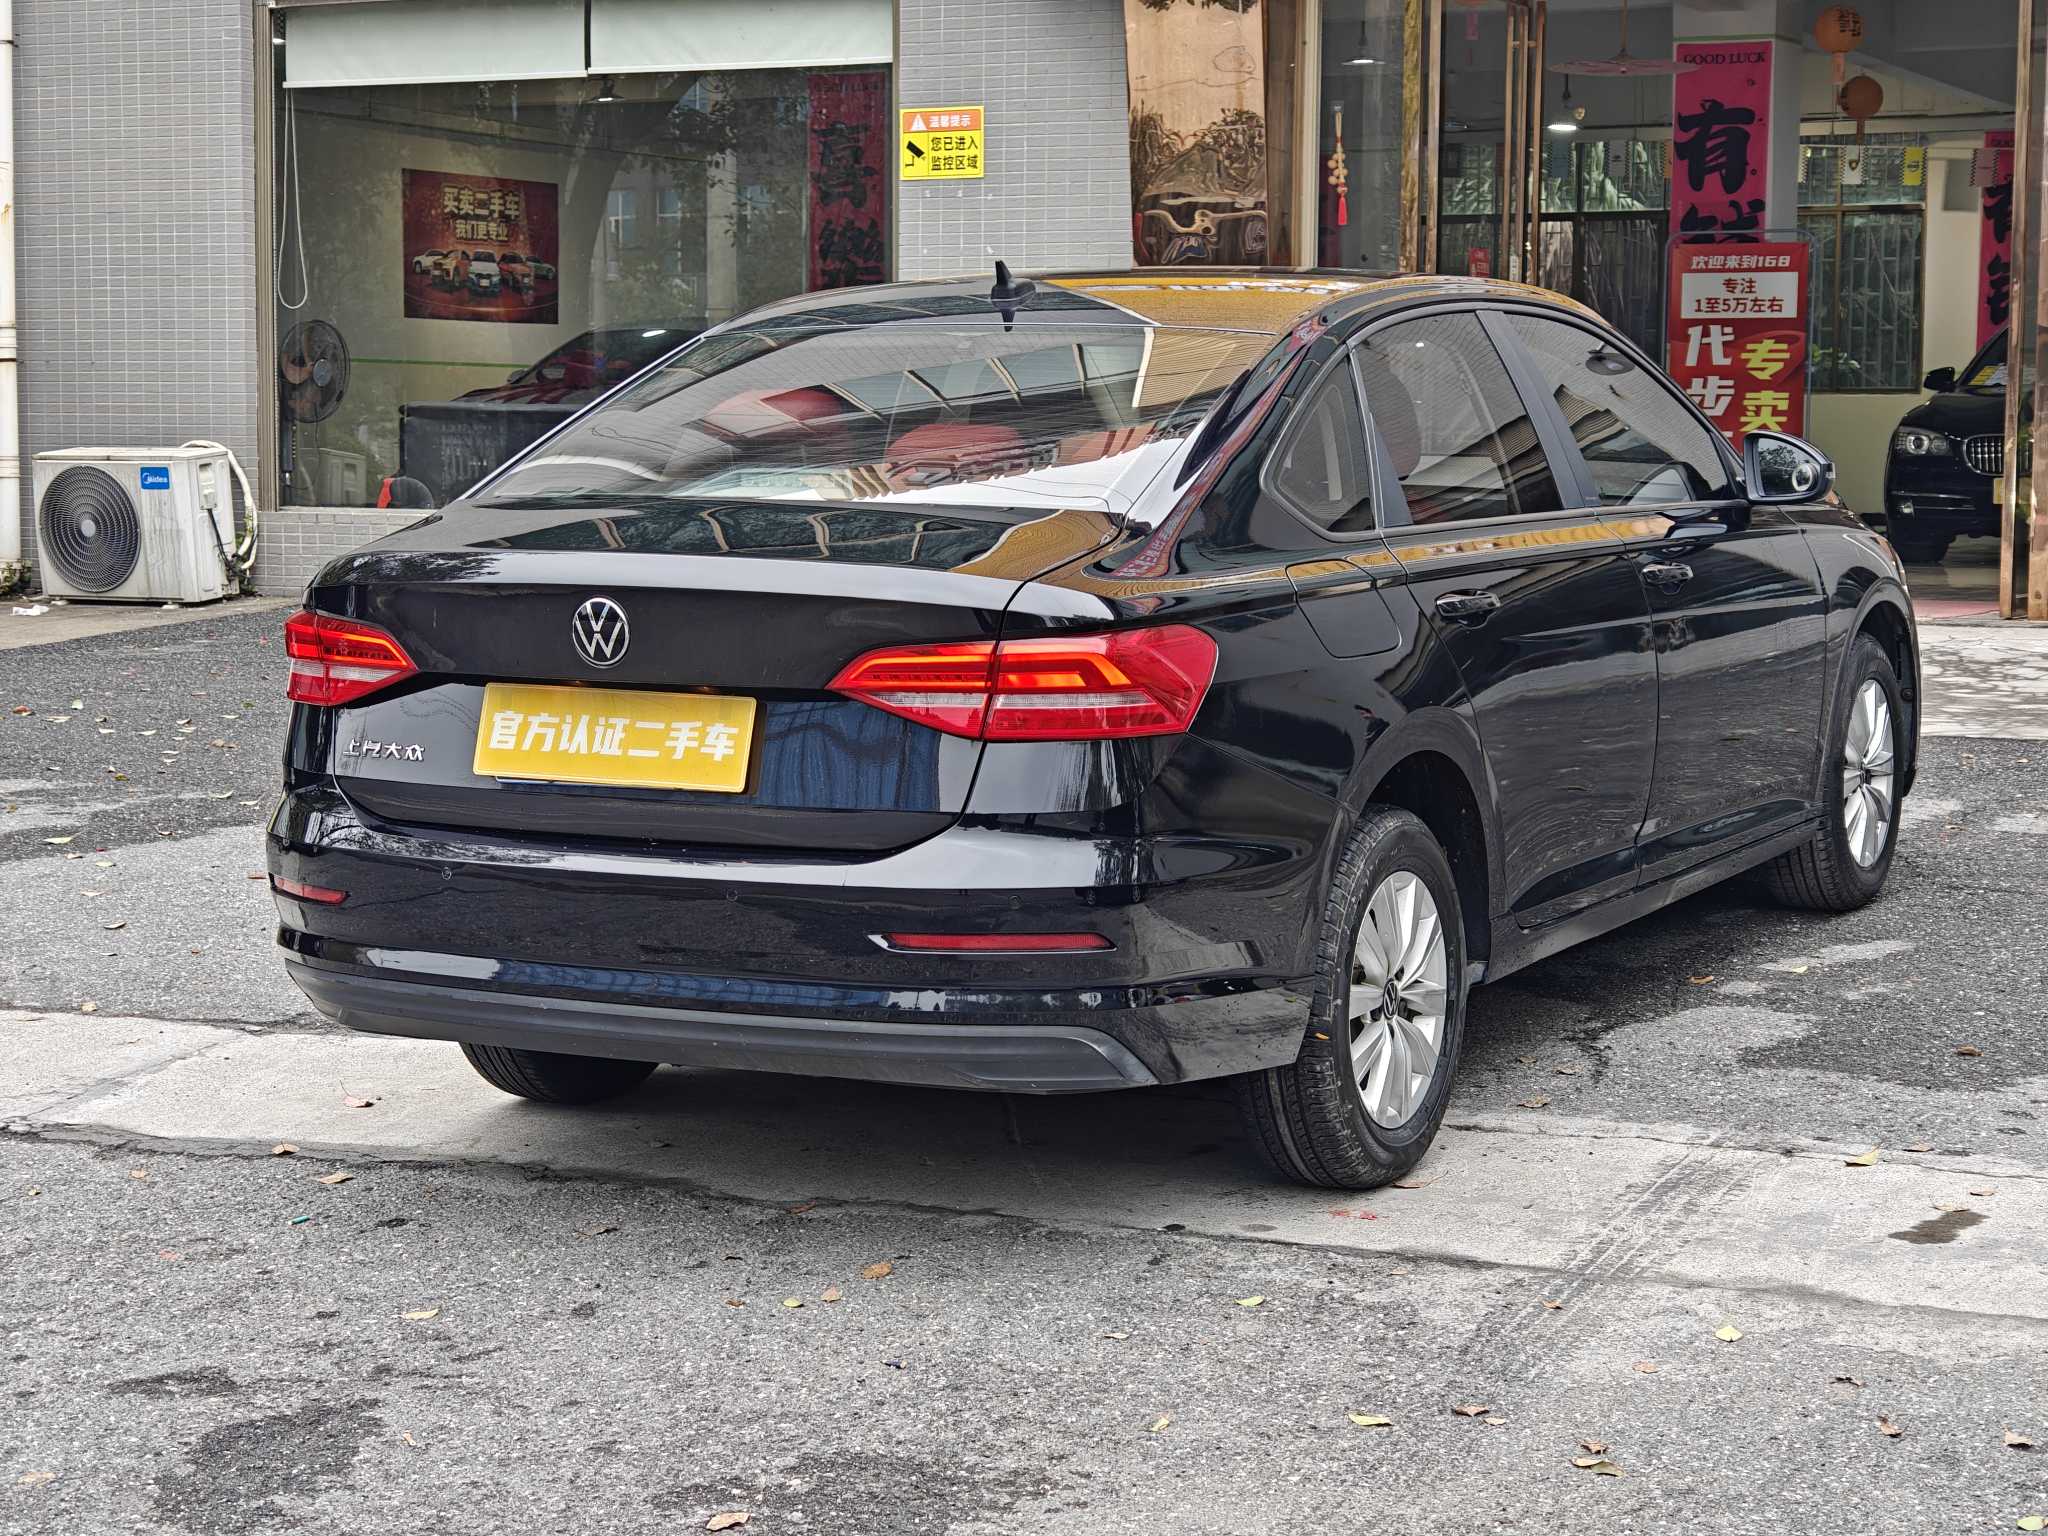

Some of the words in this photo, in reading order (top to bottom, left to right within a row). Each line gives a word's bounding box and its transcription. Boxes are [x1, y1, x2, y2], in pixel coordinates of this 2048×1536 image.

[1683, 54, 1726, 65] GOOD
[1729, 52, 1766, 64] LUCK
[930, 136, 979, 152] 您已进入
[930, 155, 979, 171] 监控区域
[443, 187, 520, 220] 买卖二手车
[455, 219, 509, 241] 我们更专业
[1690, 255, 1791, 269] 欢迎来到168
[1722, 278, 1757, 294] 专注
[1694, 297, 1784, 313] 1至5万左右
[488, 710, 740, 761] 官方认证二手车
